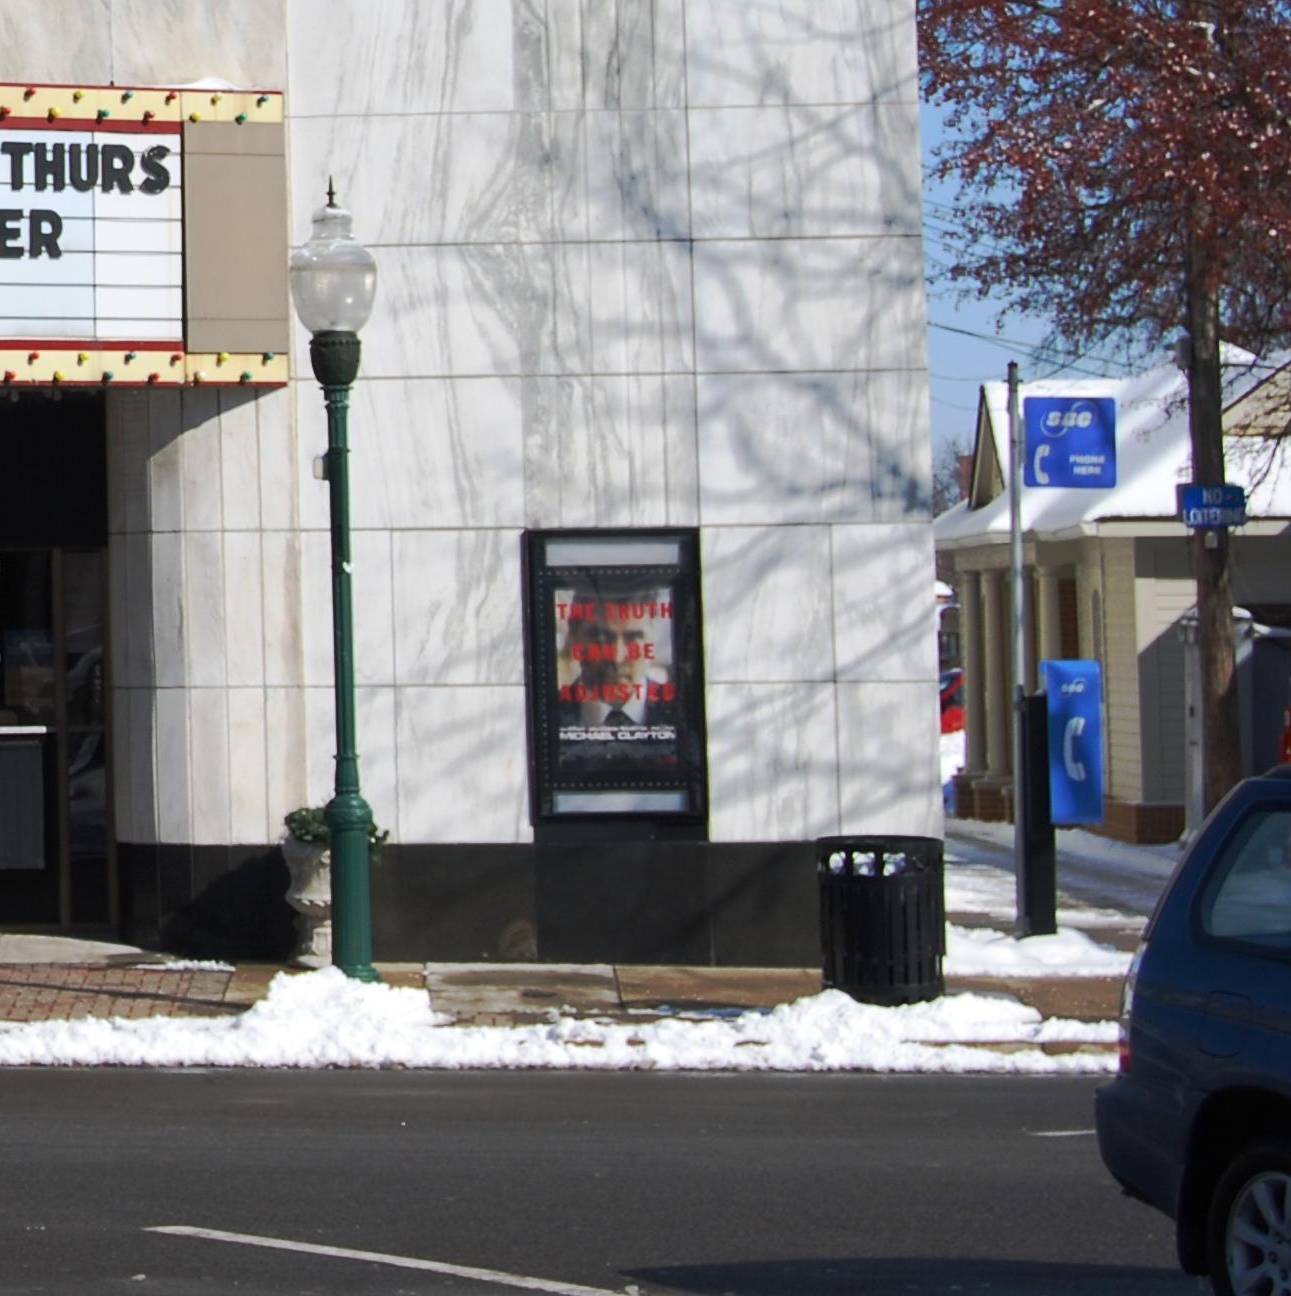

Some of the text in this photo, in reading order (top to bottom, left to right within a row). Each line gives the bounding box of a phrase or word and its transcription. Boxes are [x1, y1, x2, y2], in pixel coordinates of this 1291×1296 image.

[1, 141, 171, 194] THURS
[1201, 487, 1223, 506] NO
[1183, 507, 1245, 525] LOITERING
[556, 602, 674, 621] THE TRUTH
[571, 642, 655, 661] CAN BE
[558, 683, 675, 703] ADJUSTED
[559, 730, 676, 740] MICHAEL CLAYTON
